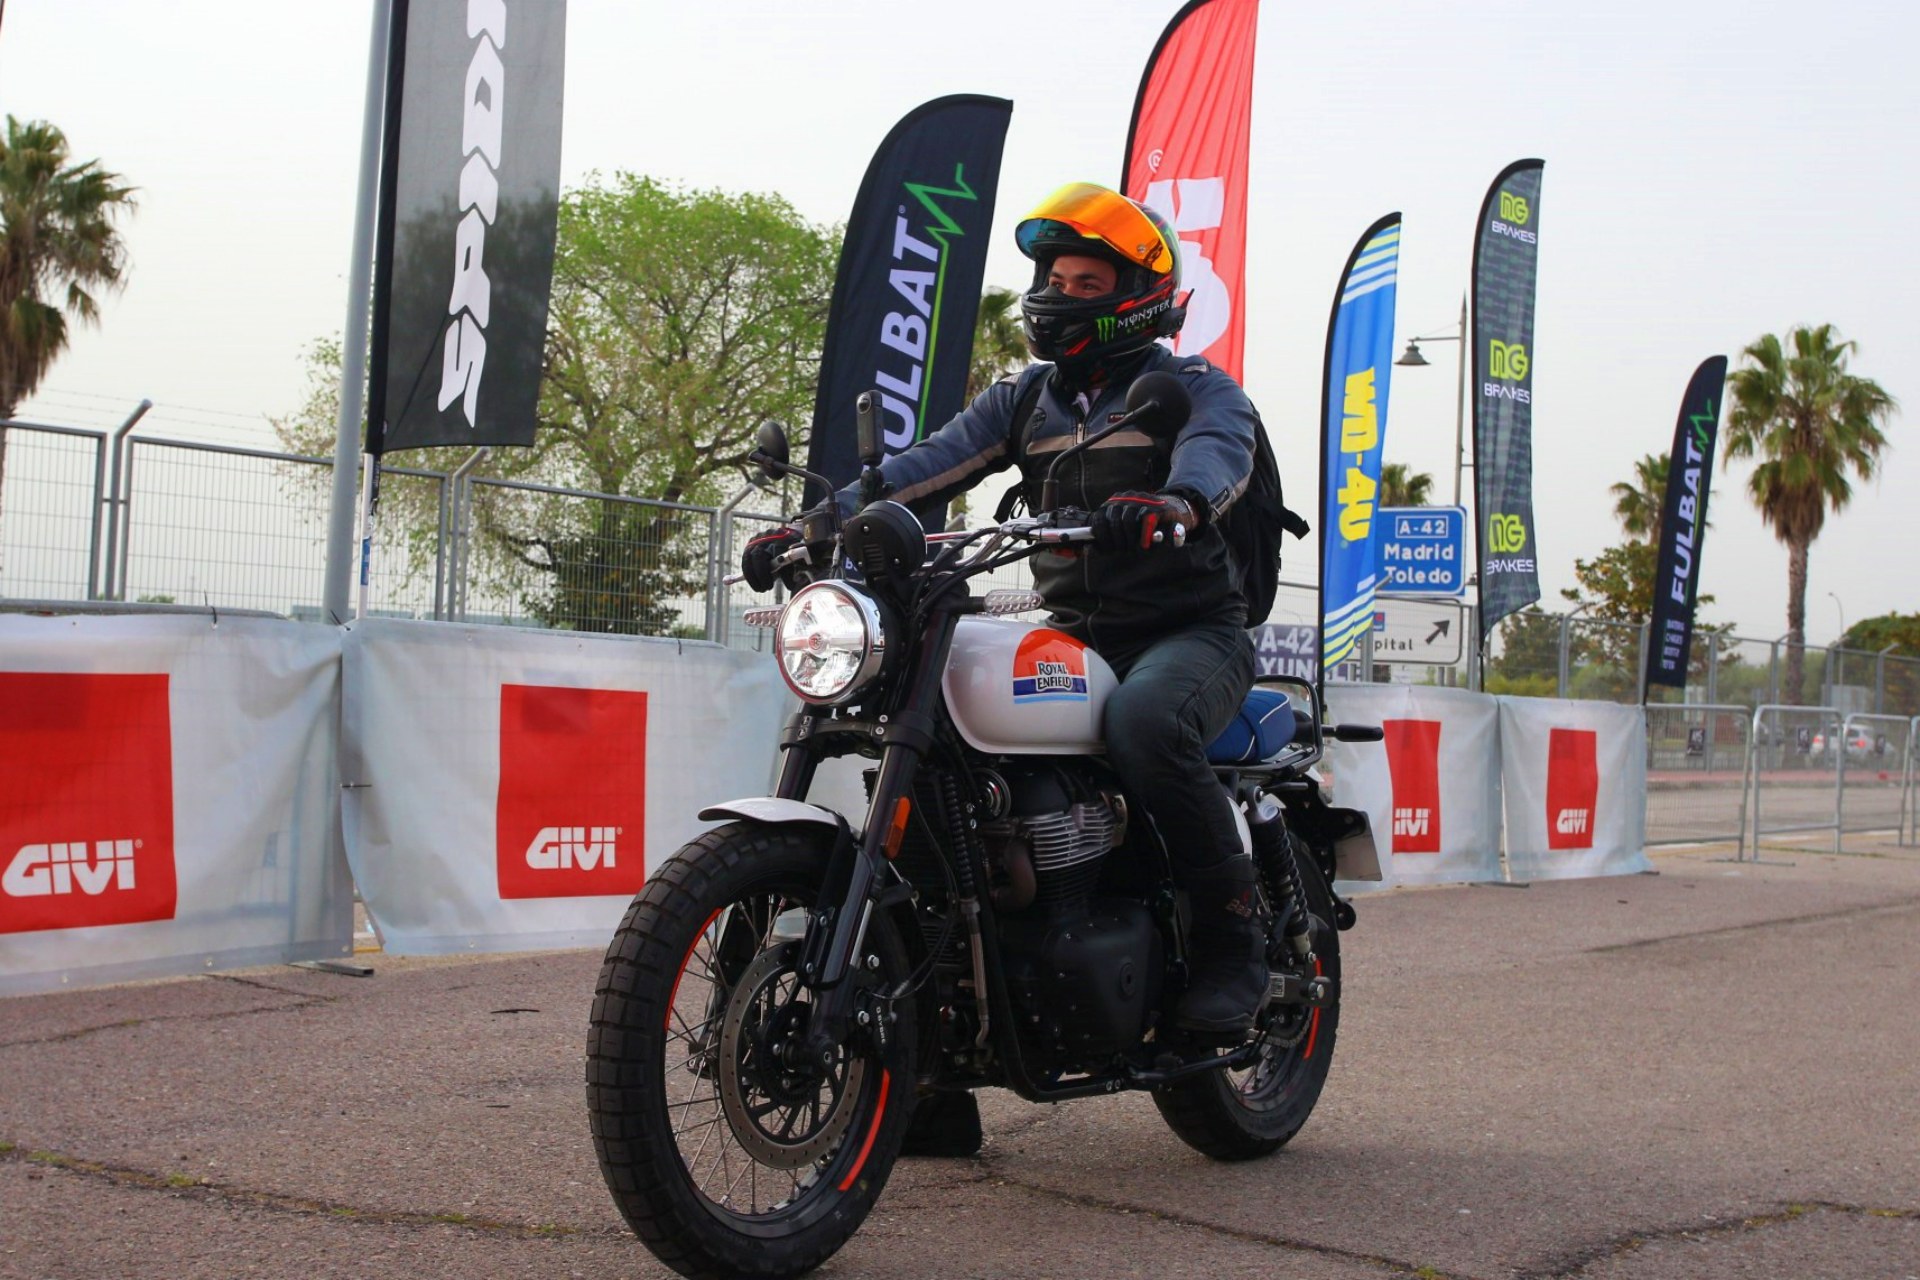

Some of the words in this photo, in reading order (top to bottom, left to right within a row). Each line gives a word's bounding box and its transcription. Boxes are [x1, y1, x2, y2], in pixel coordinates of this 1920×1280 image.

[1492, 220, 1536, 244] BRAKES
[865, 215, 939, 470] ULBAT
[1484, 382, 1530, 404] BRAKES
[1337, 366, 1378, 541] WD-40
[1400, 520, 1445, 534] A-42
[1671, 435, 1703, 605] FULBAT
[1384, 543, 1454, 560] Madrid
[1384, 566, 1452, 584] Toledo
[1486, 559, 1534, 575] BRAKES
[1357, 637, 1413, 652] pital
[1037, 662, 1067, 676] ROYAL
[1036, 676, 1072, 690] ENFIELD
[1393, 807, 1429, 837] IVI
[1556, 808, 1587, 835] GIVI
[525, 826, 616, 871] GIVI
[1, 839, 136, 898] GIVI
